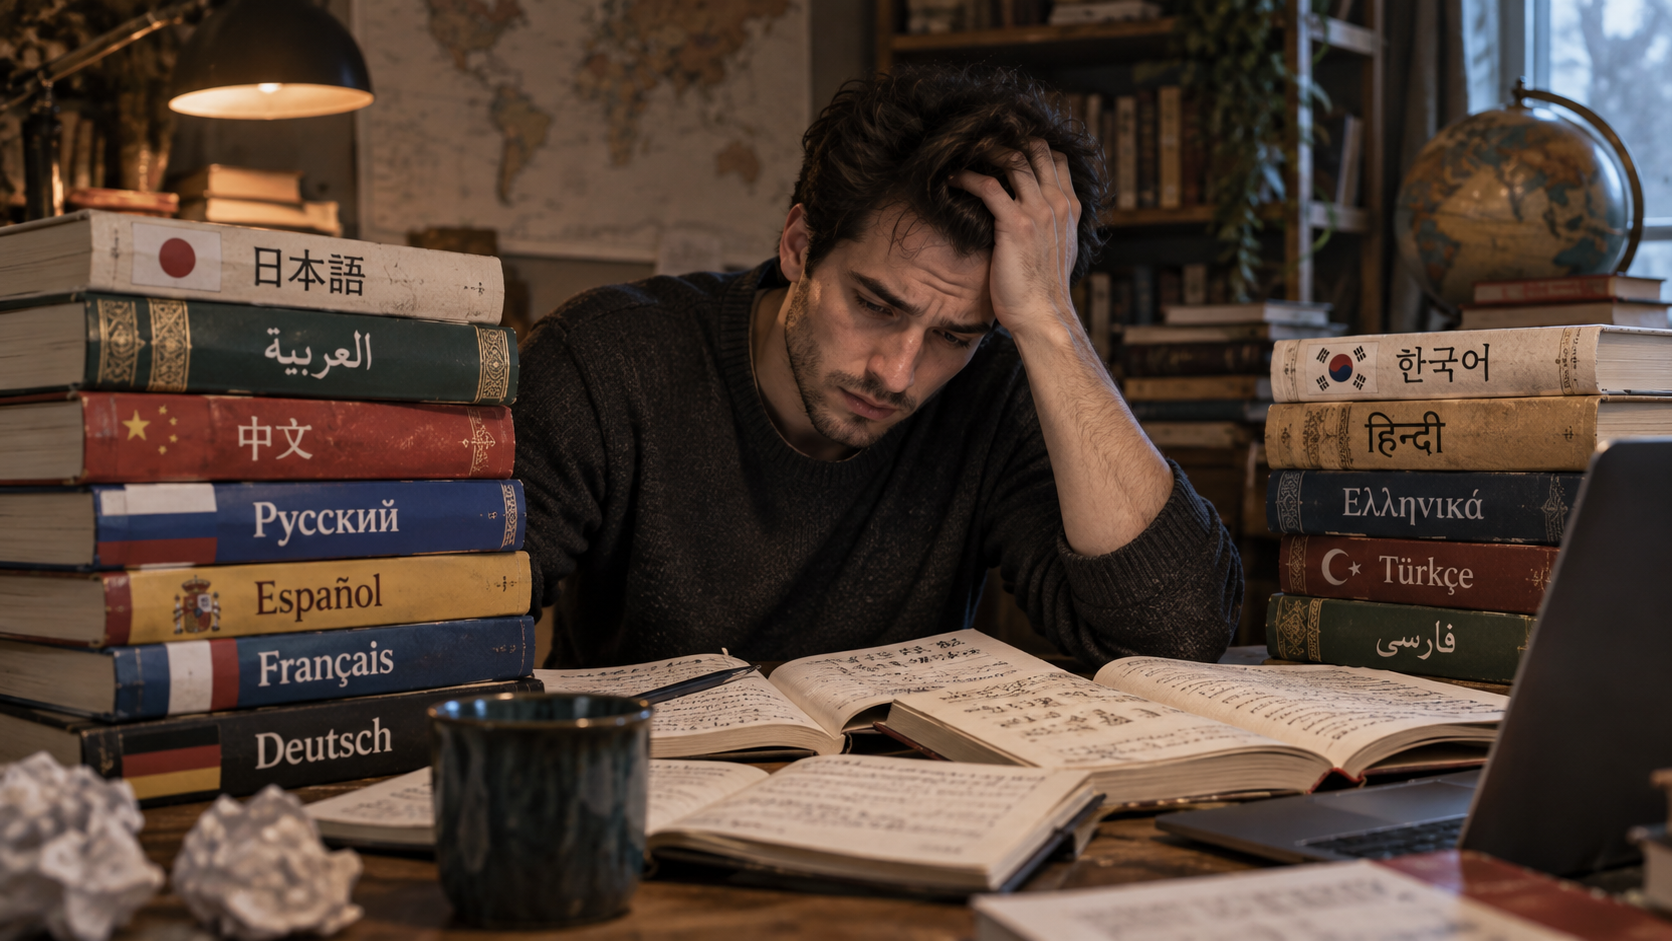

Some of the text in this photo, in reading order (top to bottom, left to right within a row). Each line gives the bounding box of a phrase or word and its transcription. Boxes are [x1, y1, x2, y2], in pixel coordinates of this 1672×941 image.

[253, 246, 366, 296] 日本語
[264, 327, 372, 379] العربية
[1395, 343, 1490, 383] 한국어
[237, 416, 313, 461] 中文
[1364, 410, 1446, 458] हिन्दी
[252, 499, 399, 546] Русский
[1342, 487, 1485, 526] Ελληνικά
[254, 573, 383, 622] Español
[1378, 555, 1474, 596] Türkçe
[1376, 620, 1456, 660] فارسی
[257, 640, 394, 688] Français
[255, 717, 393, 770] Deutsch
